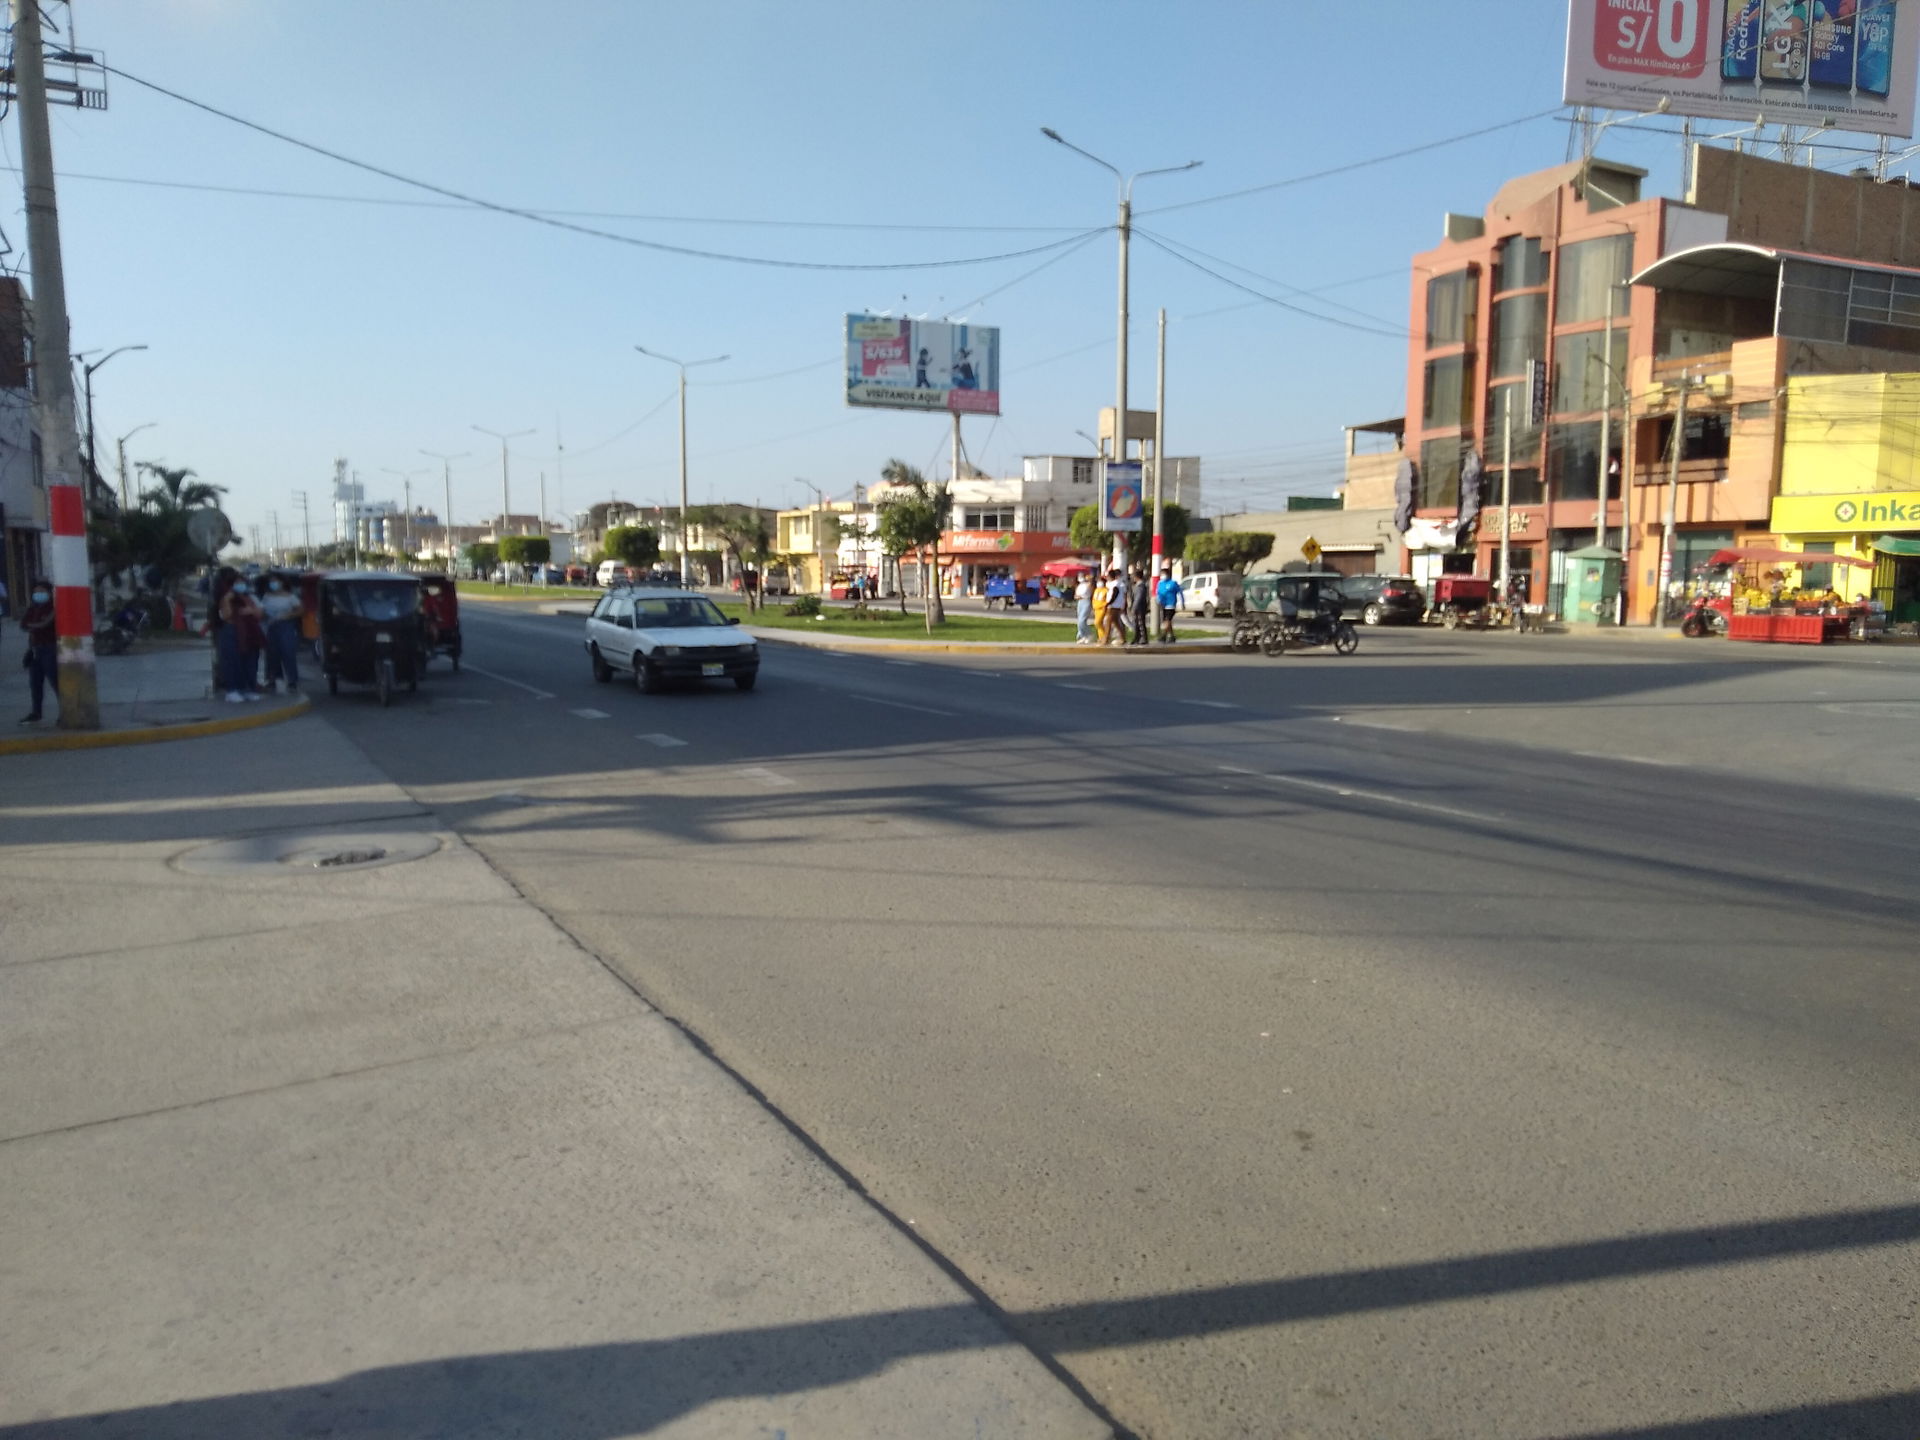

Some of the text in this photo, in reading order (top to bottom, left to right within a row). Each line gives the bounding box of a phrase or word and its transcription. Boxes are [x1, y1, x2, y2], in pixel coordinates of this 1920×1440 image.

[1814, 21, 1852, 34] SAMSUNG
[1814, 31, 1840, 43] Galaxy
[1772, 35, 1791, 68] LG
[1827, 42, 1845, 52] Core
[1862, 499, 1920, 521] Inka
[952, 534, 996, 547] Mifarma
